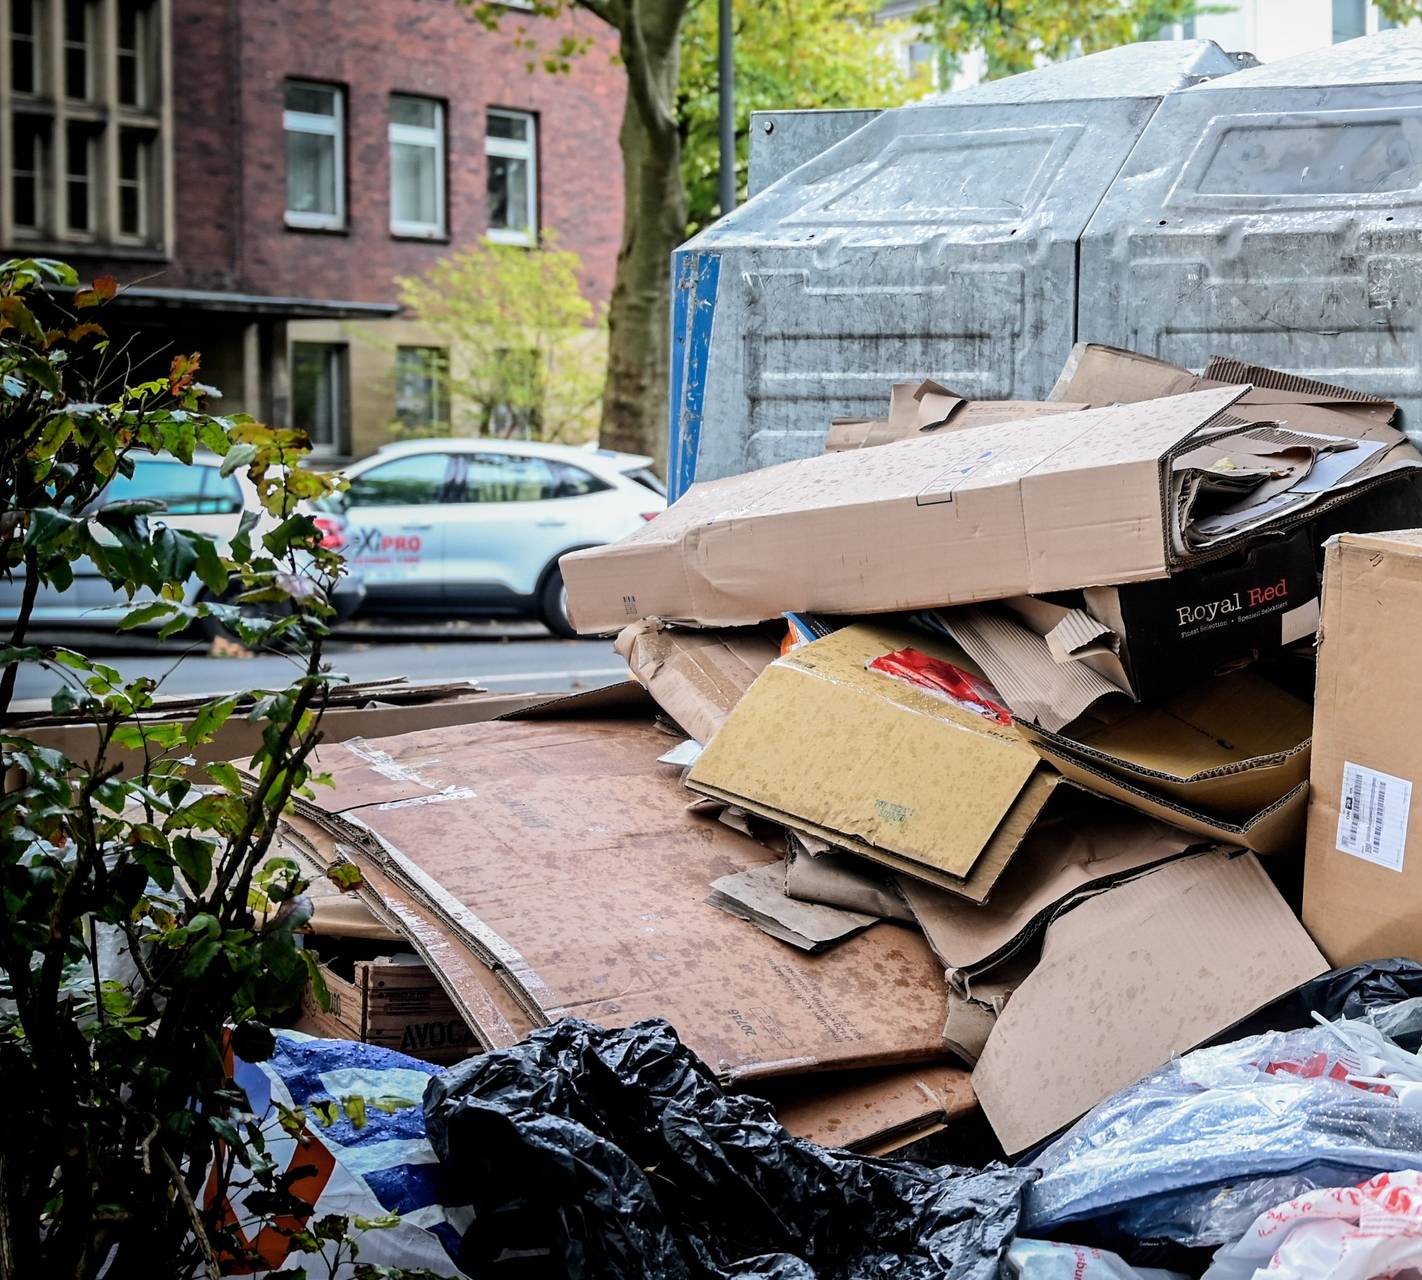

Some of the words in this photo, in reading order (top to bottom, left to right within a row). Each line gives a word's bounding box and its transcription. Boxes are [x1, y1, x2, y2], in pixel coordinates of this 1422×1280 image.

[1176, 593, 1243, 627] Royal
[1248, 578, 1289, 607] Red
[1200, 620, 1228, 633] Selection
